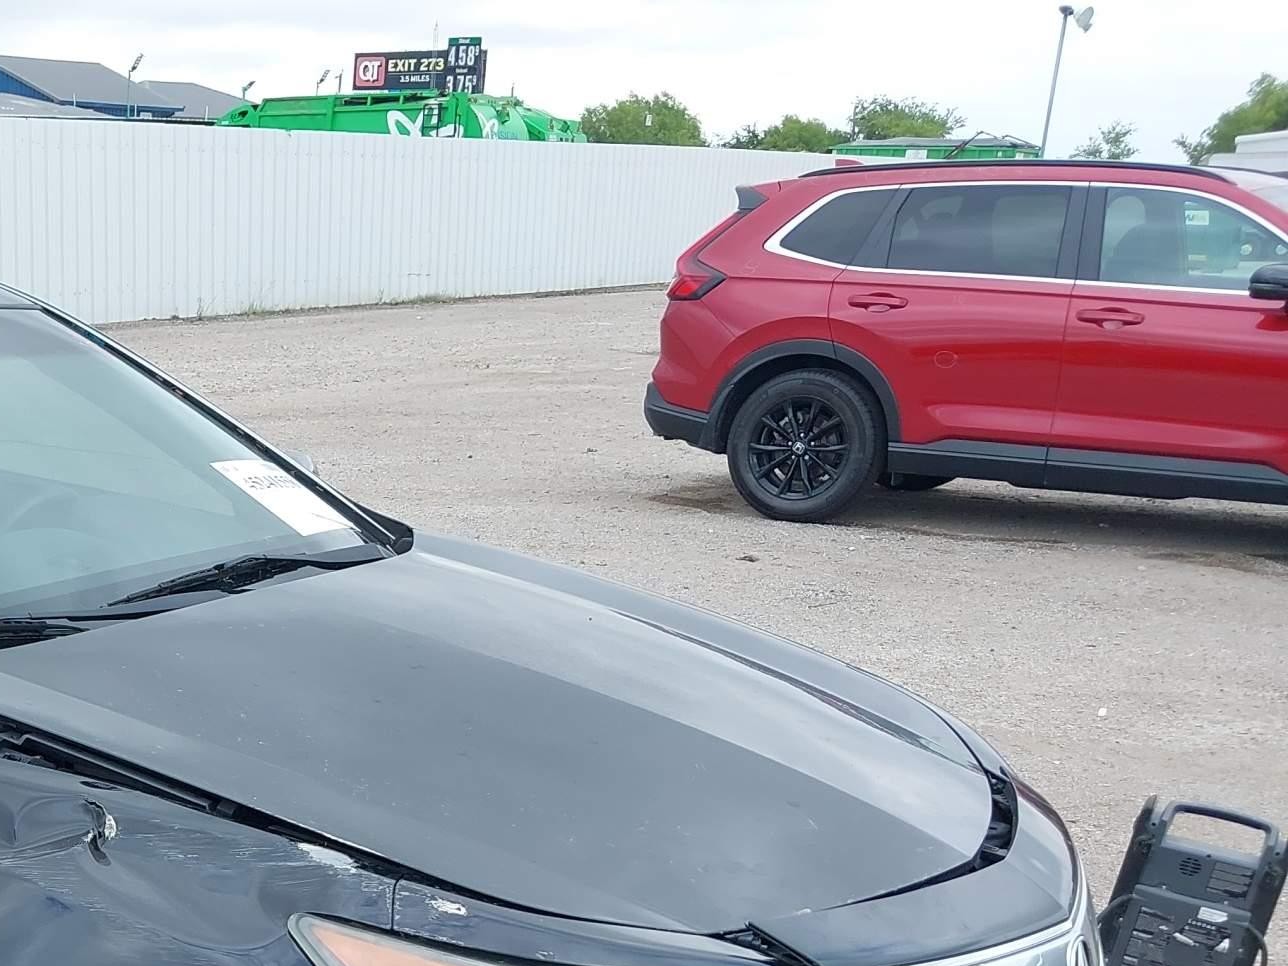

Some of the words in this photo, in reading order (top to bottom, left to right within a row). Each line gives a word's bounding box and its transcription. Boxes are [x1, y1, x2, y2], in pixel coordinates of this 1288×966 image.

[359, 61, 382, 82] QT
[387, 59, 417, 72] EXIT
[419, 58, 444, 71] 273
